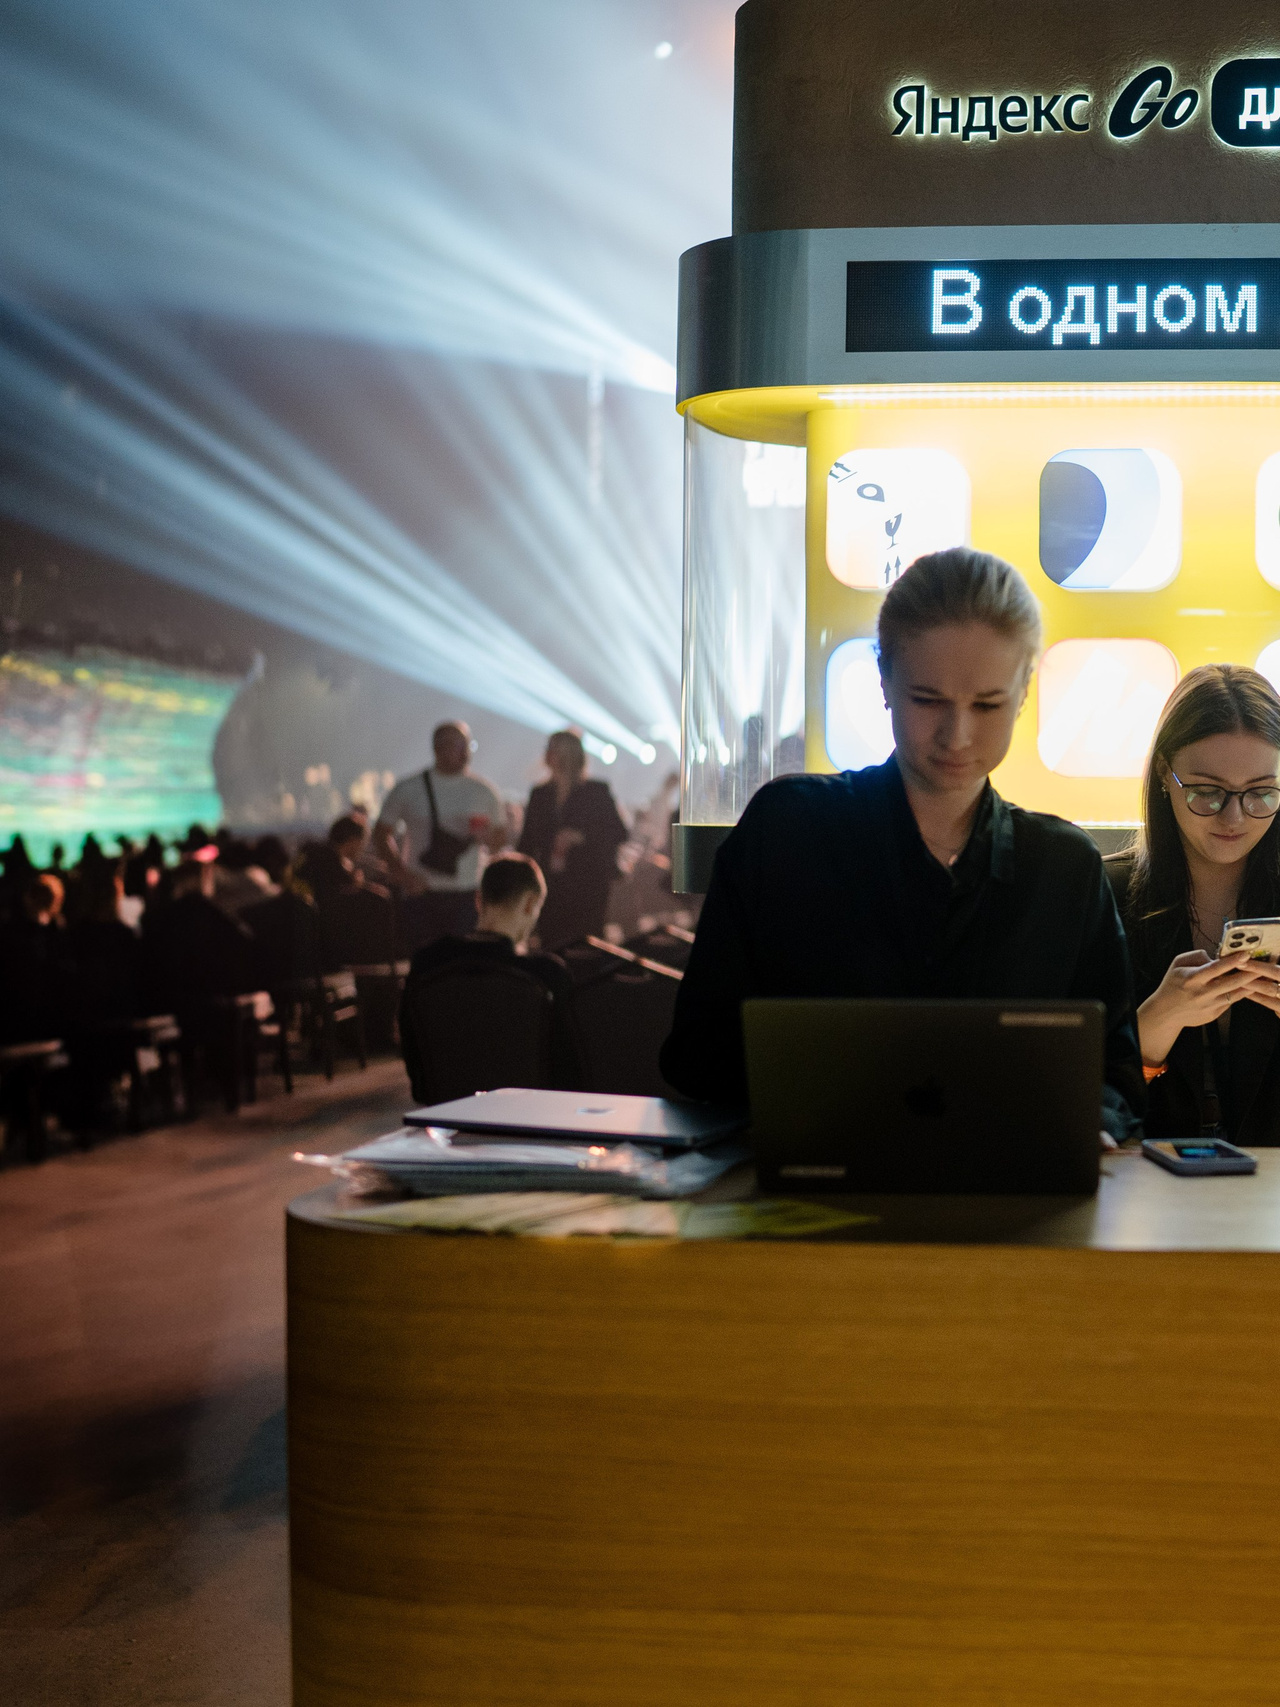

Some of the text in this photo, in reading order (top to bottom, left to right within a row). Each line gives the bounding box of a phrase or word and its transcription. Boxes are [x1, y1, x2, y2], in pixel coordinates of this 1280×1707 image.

[891, 83, 1090, 142] Яндекс
[1107, 65, 1200, 139] Go
[931, 269, 983, 334] В
[1008, 284, 1258, 345] одном
